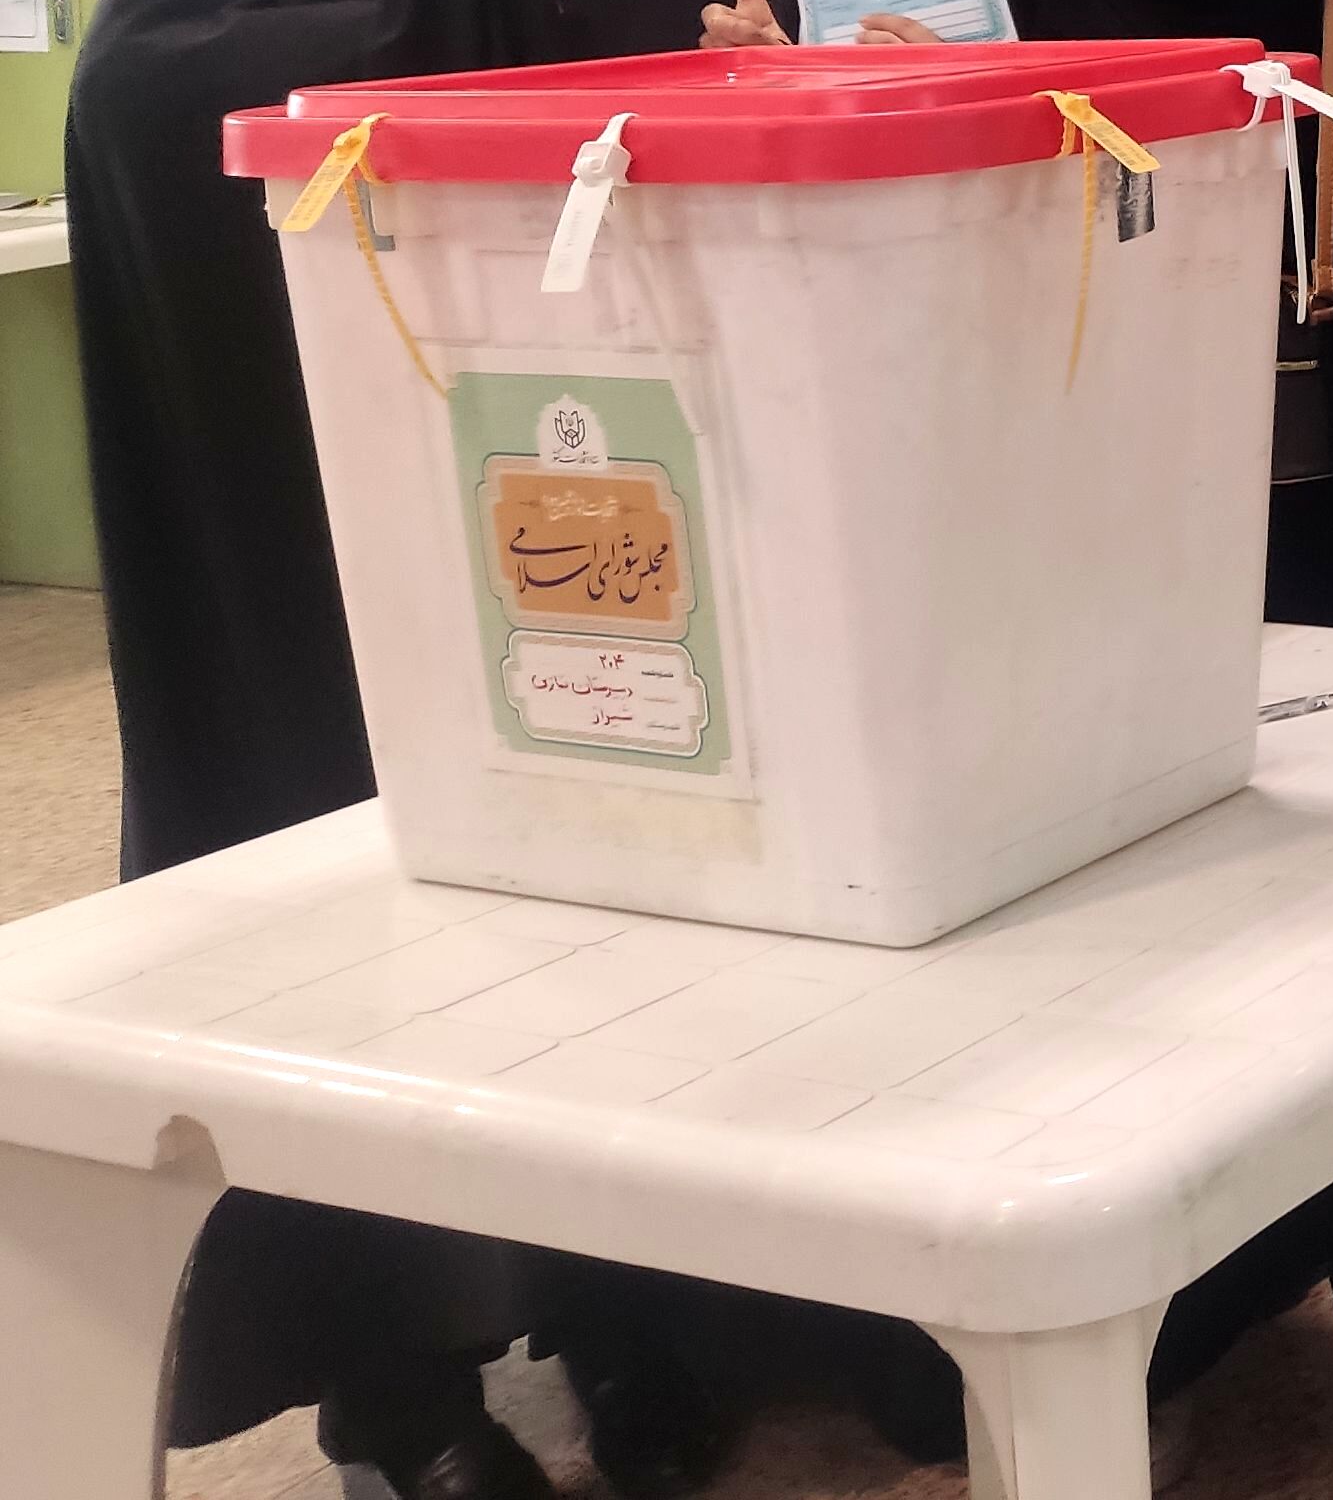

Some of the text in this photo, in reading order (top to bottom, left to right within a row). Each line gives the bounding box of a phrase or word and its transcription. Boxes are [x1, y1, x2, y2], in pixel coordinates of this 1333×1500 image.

[509, 527, 668, 604] مجلس شورای اسلامی
